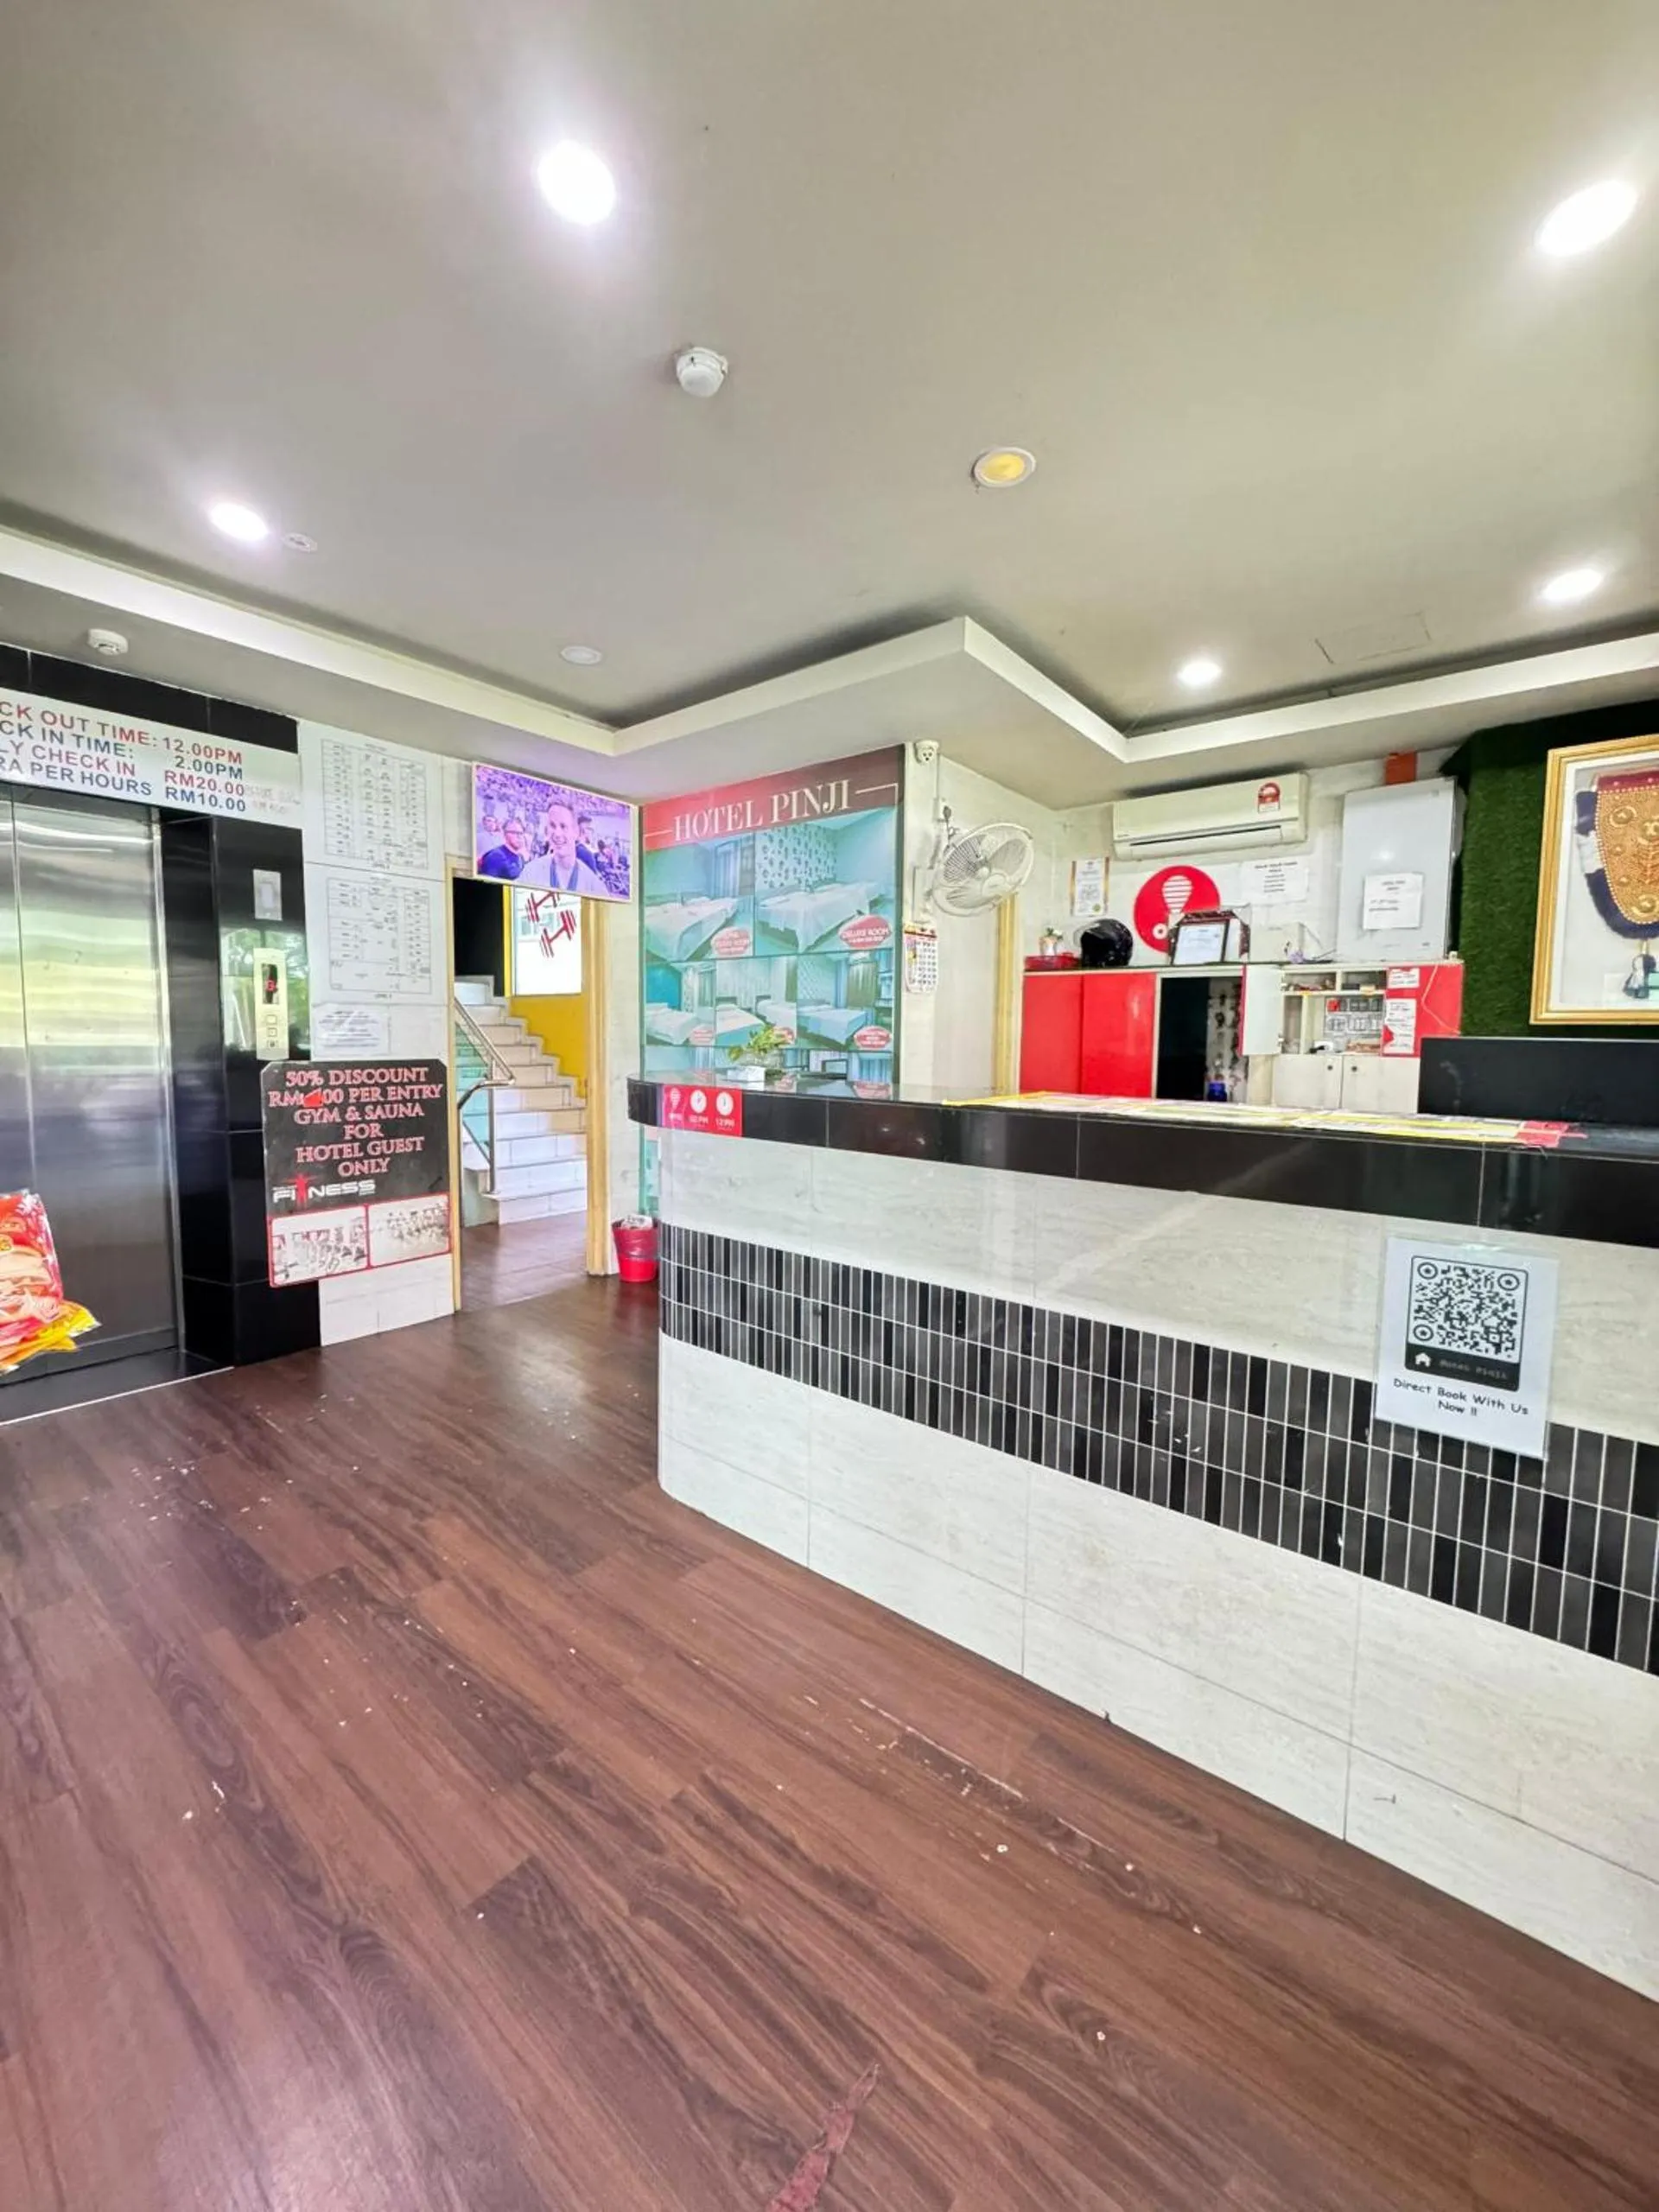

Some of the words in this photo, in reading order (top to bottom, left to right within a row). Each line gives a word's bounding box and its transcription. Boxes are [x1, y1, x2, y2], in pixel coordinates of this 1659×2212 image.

[41, 710, 90, 732] OUT
[97, 722, 157, 747] TIME:
[162, 737, 242, 765] 12.00PM
[41, 728, 64, 745] IN
[71, 734, 134, 759] TIME:
[175, 755, 243, 780] 2.00PM
[32, 745, 111, 772] CHECK
[117, 761, 136, 777] IN
[164, 770, 245, 797] RM20.00
[30, 762, 74, 783] PER
[81, 771, 152, 796] HOURS
[165, 787, 245, 812] RM10.00
[674, 800, 763, 842] HOTEL
[770, 779, 850, 823] PINJI
[286, 1070, 324, 1087] 50%
[328, 1067, 429, 1085] DISCOUNT
[348, 1087, 385, 1103] PER
[387, 1084, 443, 1101] ENTRY
[294, 1108, 341, 1124] GYM
[345, 1106, 362, 1122] &
[365, 1103, 425, 1121] SAUNA
[343, 1123, 384, 1141] FOR
[296, 1142, 364, 1163] HOTEL
[366, 1137, 425, 1155] GUEST
[337, 1157, 391, 1178] ONLY
[1394, 1378, 1431, 1395] Direct
[1438, 1387, 1467, 1402] Book
[1472, 1394, 1505, 1410] With
[1511, 1403, 1529, 1415] Us
[1438, 1400, 1465, 1414] Now
